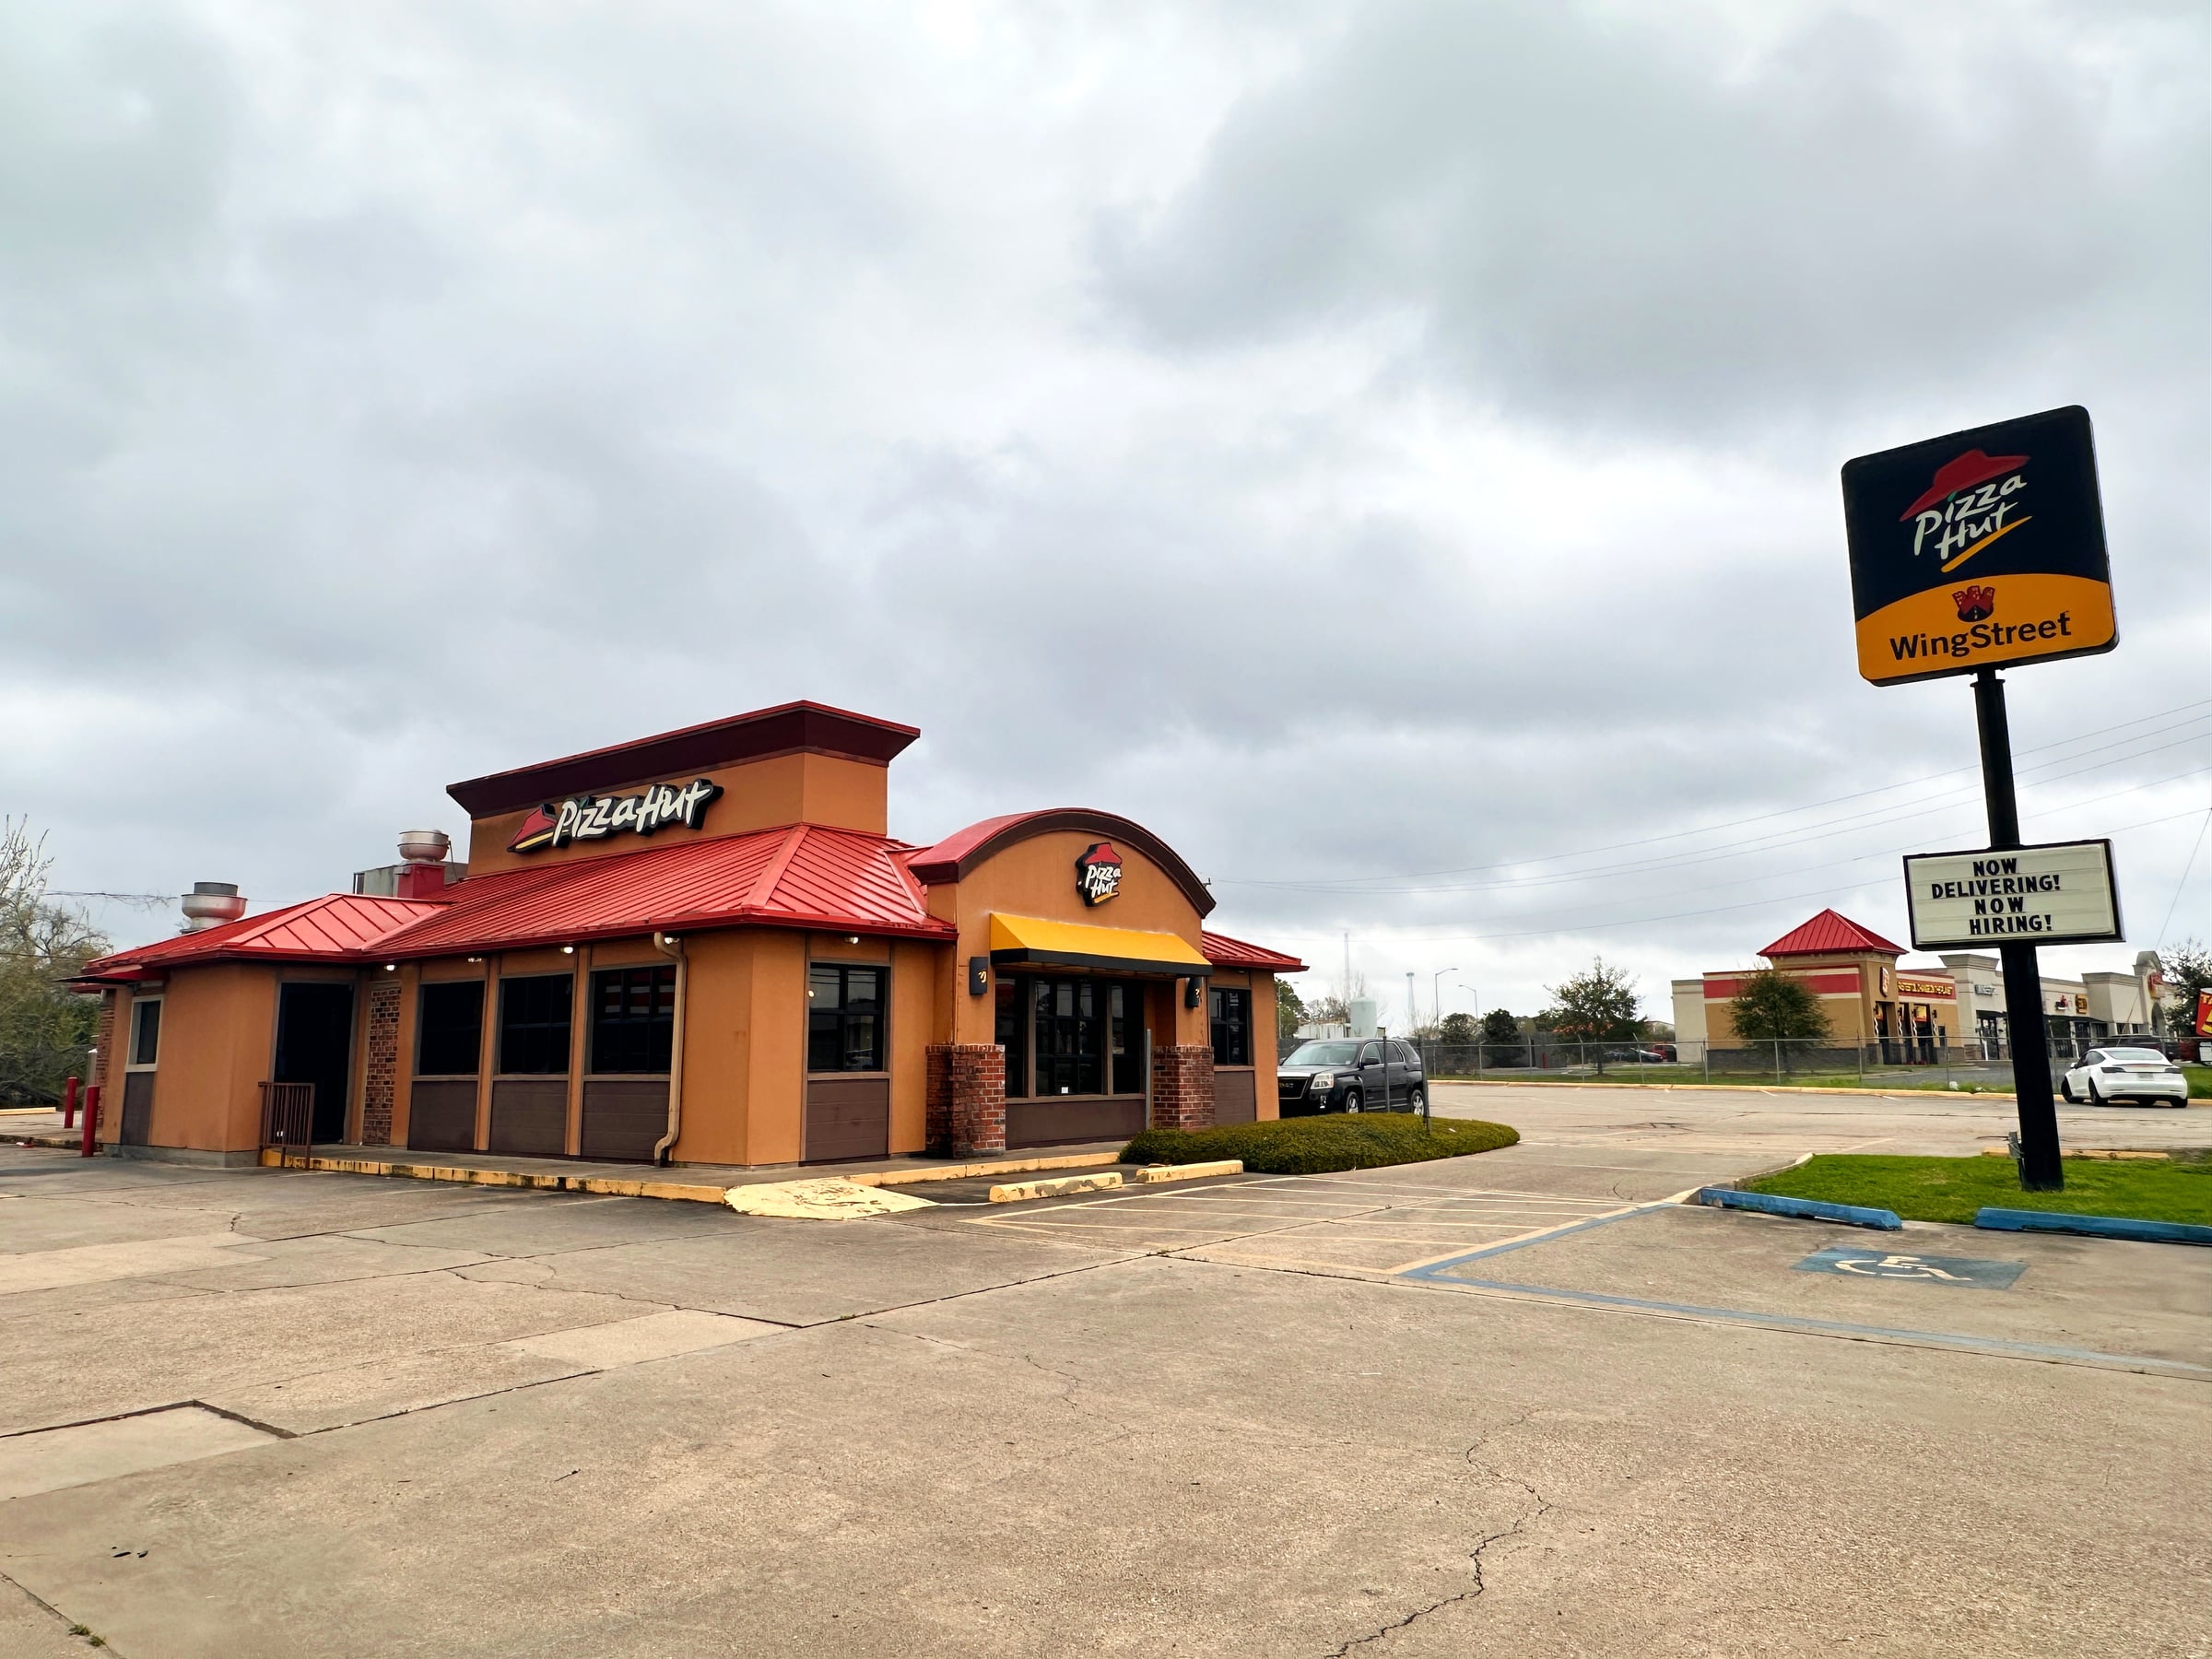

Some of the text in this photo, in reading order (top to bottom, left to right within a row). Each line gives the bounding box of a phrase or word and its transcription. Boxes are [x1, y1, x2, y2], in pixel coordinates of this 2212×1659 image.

[1913, 475, 2027, 556] Pizza
[1935, 501, 2018, 559] Hut
[1889, 610, 2071, 660] WingStreet
[1085, 865, 1122, 888] Pizza
[1972, 857, 2018, 877] NOW
[1090, 878, 1118, 899] Hut
[1932, 875, 2061, 900] DELIVERING!
[1974, 897, 2024, 915] NOW
[1969, 914, 2053, 935] HIRING!
